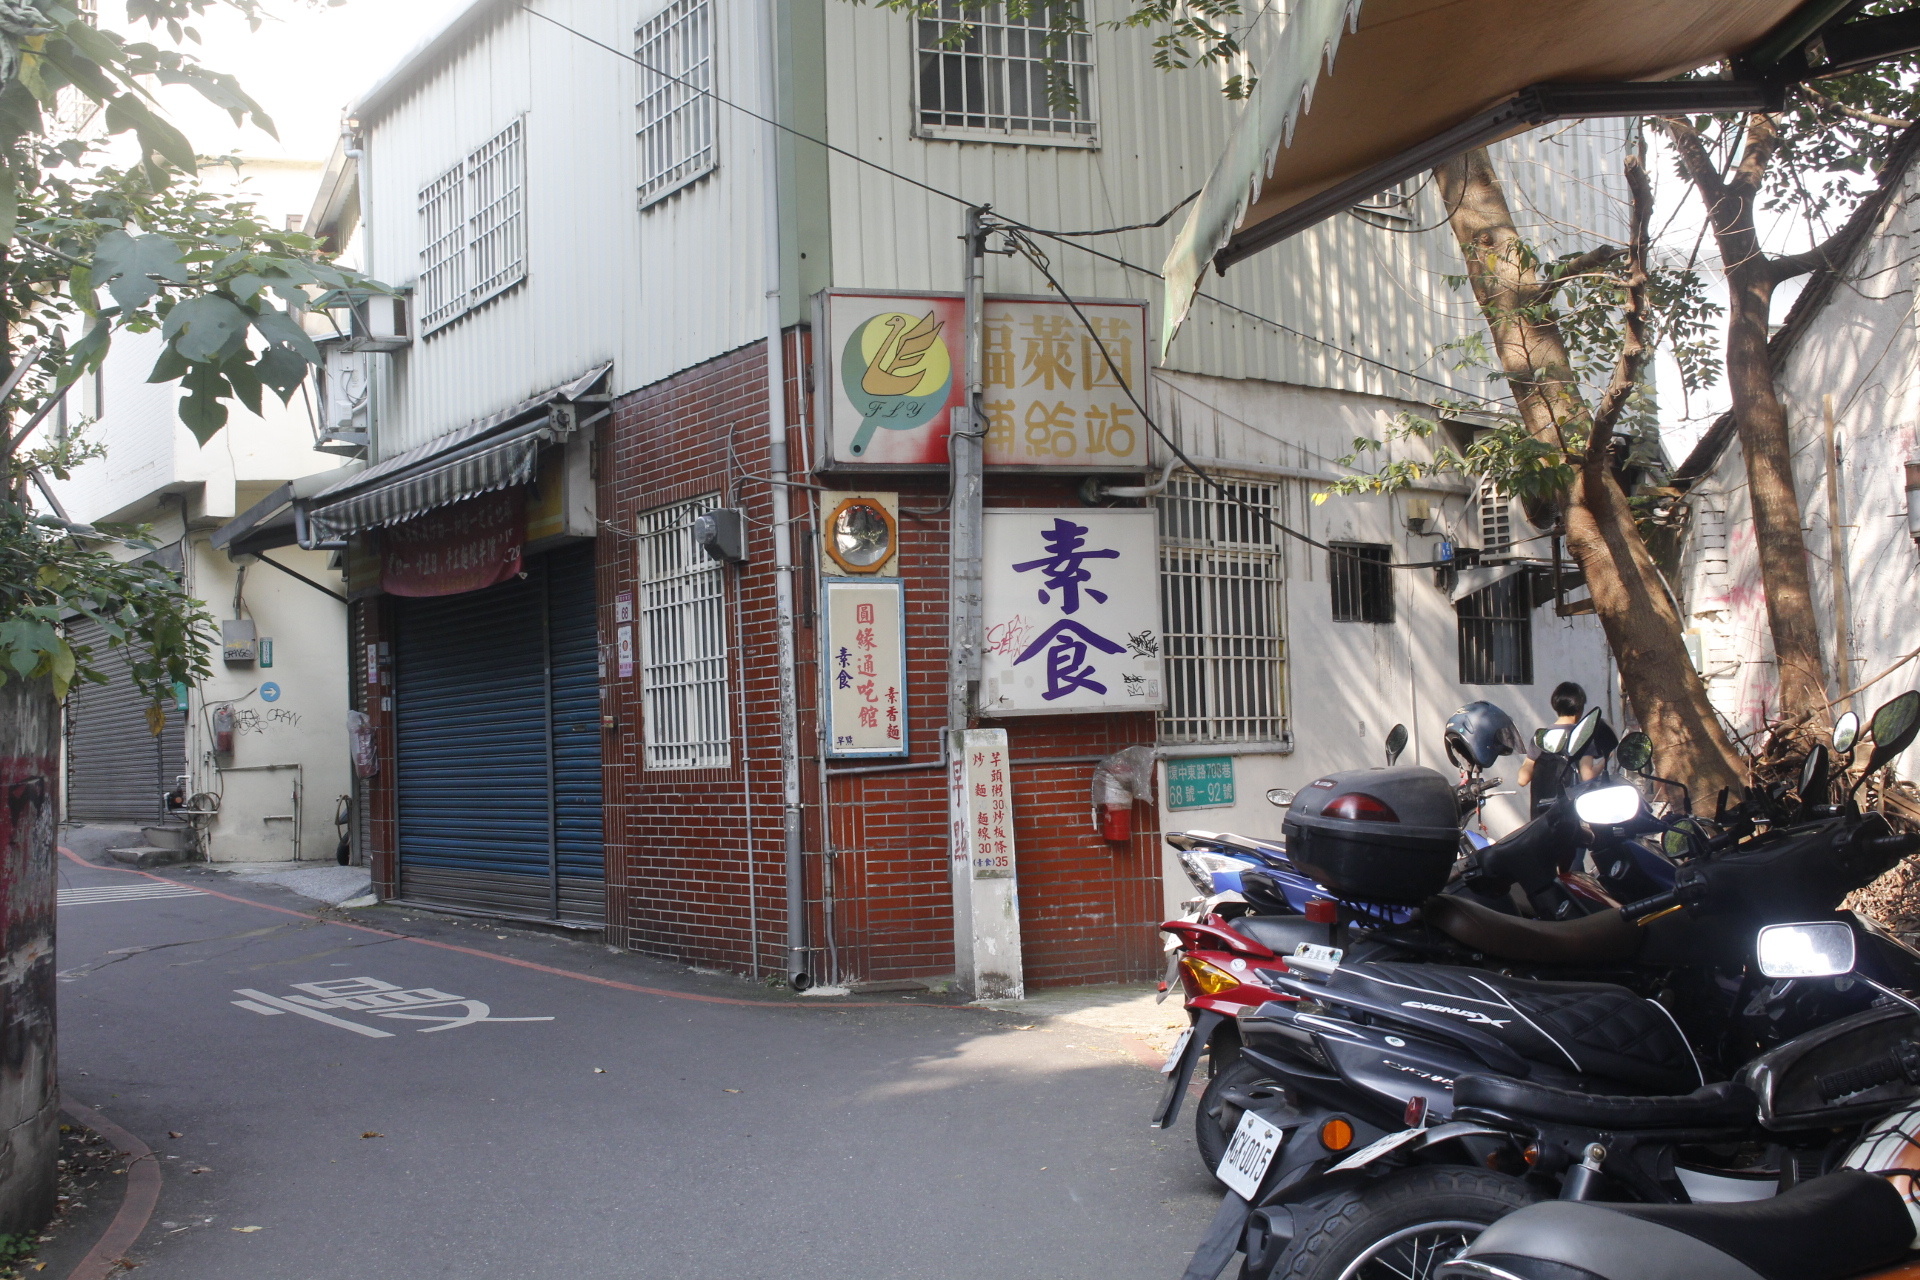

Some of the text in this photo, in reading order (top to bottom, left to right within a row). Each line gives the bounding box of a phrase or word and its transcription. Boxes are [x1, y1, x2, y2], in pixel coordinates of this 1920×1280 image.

[1012, 518, 1127, 701] 素食
[835, 646, 854, 690] 素食
[855, 602, 879, 729] 圓緣通吃館
[952, 759, 968, 861] 早點
[992, 799, 1005, 811] 30
[978, 842, 992, 854] 30
[995, 856, 1009, 867] 35
[229, 976, 556, 1038] 慢
